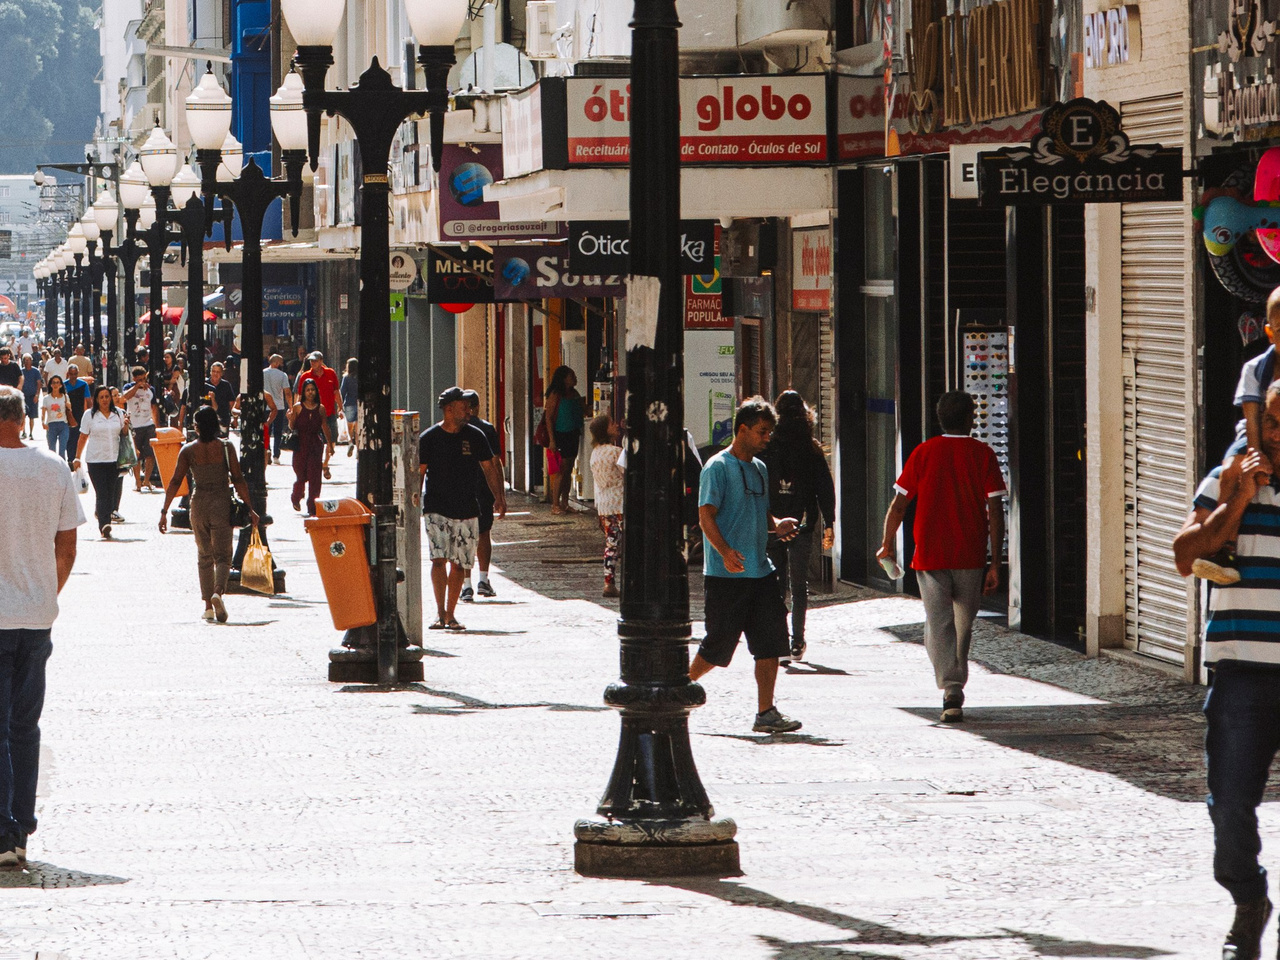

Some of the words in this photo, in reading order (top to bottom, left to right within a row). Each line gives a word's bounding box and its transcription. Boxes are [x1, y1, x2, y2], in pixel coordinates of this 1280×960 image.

[696, 85, 812, 132] globo
[681, 142, 696, 156] de
[697, 141, 739, 156] Contato
[748, 140, 785, 155] Óculos
[787, 141, 802, 155] de
[803, 141, 821, 155] Sol
[999, 167, 1166, 199] Elegância
[687, 296, 721, 310] FARMÁC
